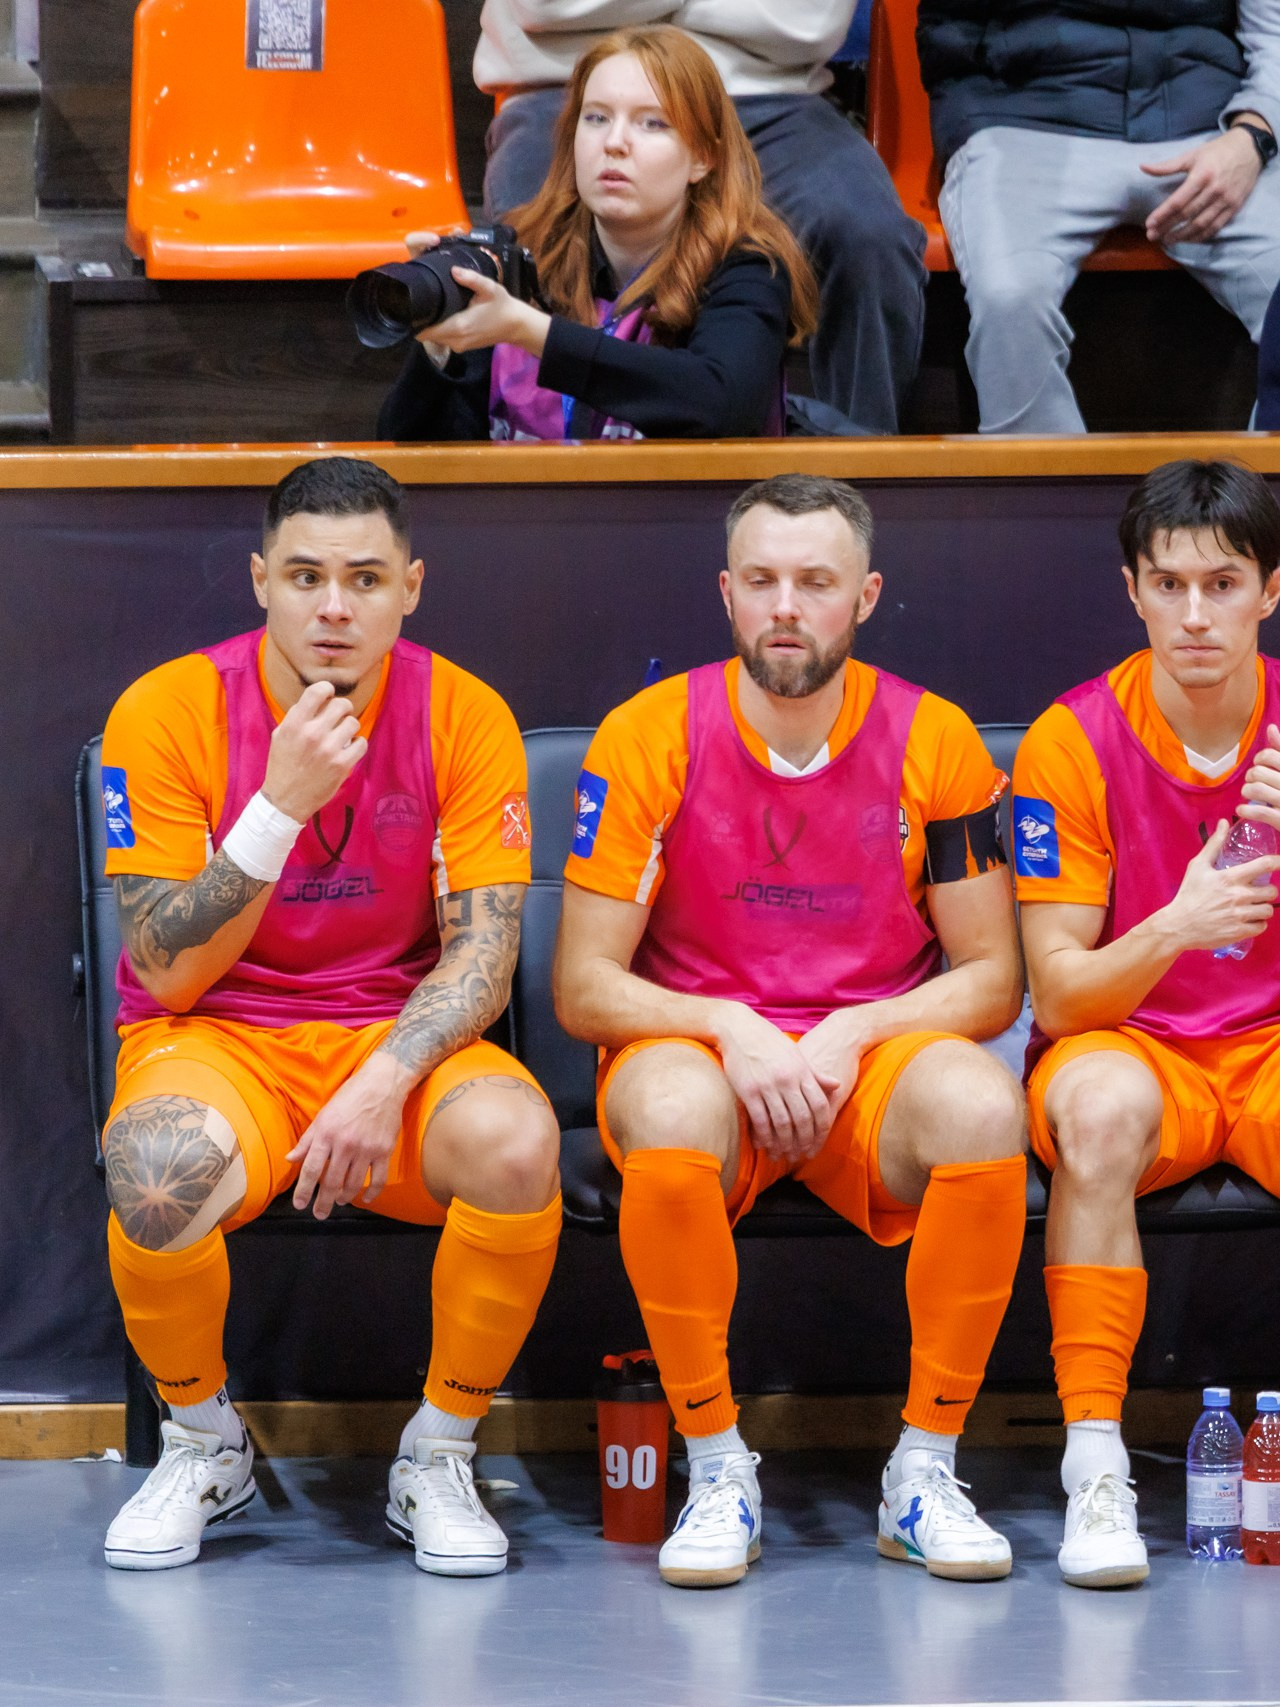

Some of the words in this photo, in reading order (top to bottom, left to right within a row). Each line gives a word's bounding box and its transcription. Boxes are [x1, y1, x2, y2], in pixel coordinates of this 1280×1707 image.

[282, 876, 384, 902] JÖGEL
[720, 876, 825, 913] JÖGEL
[605, 1444, 657, 1490] 90
